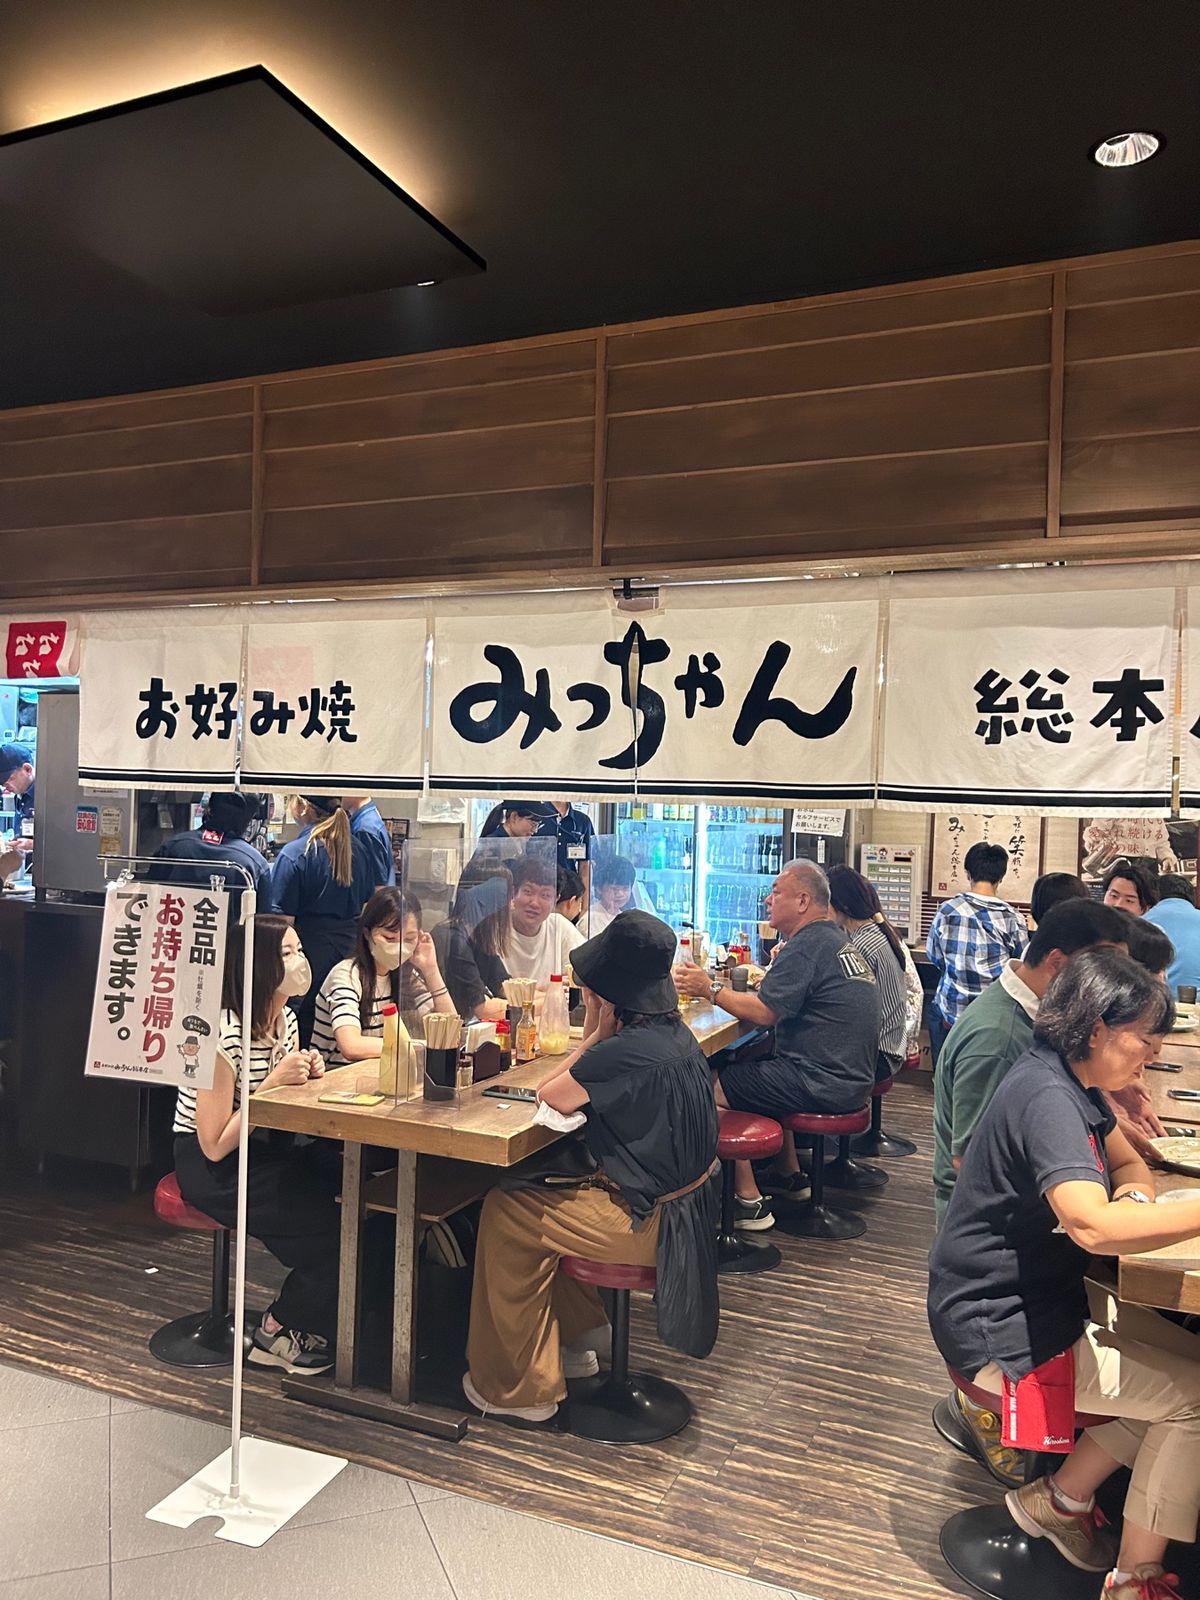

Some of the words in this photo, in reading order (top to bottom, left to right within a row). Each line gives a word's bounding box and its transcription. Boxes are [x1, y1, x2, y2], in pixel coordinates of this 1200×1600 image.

[136, 678, 358, 743] お好み焼
[449, 620, 857, 769] みっちゃん
[974, 667, 1200, 746] 総本
[795, 821, 830, 830] お願いします。
[796, 814, 841, 823] セルフサービスで
[104, 892, 149, 1041] できます。
[142, 893, 186, 1064] お持ち帰り
[190, 897, 220, 967] 全品
